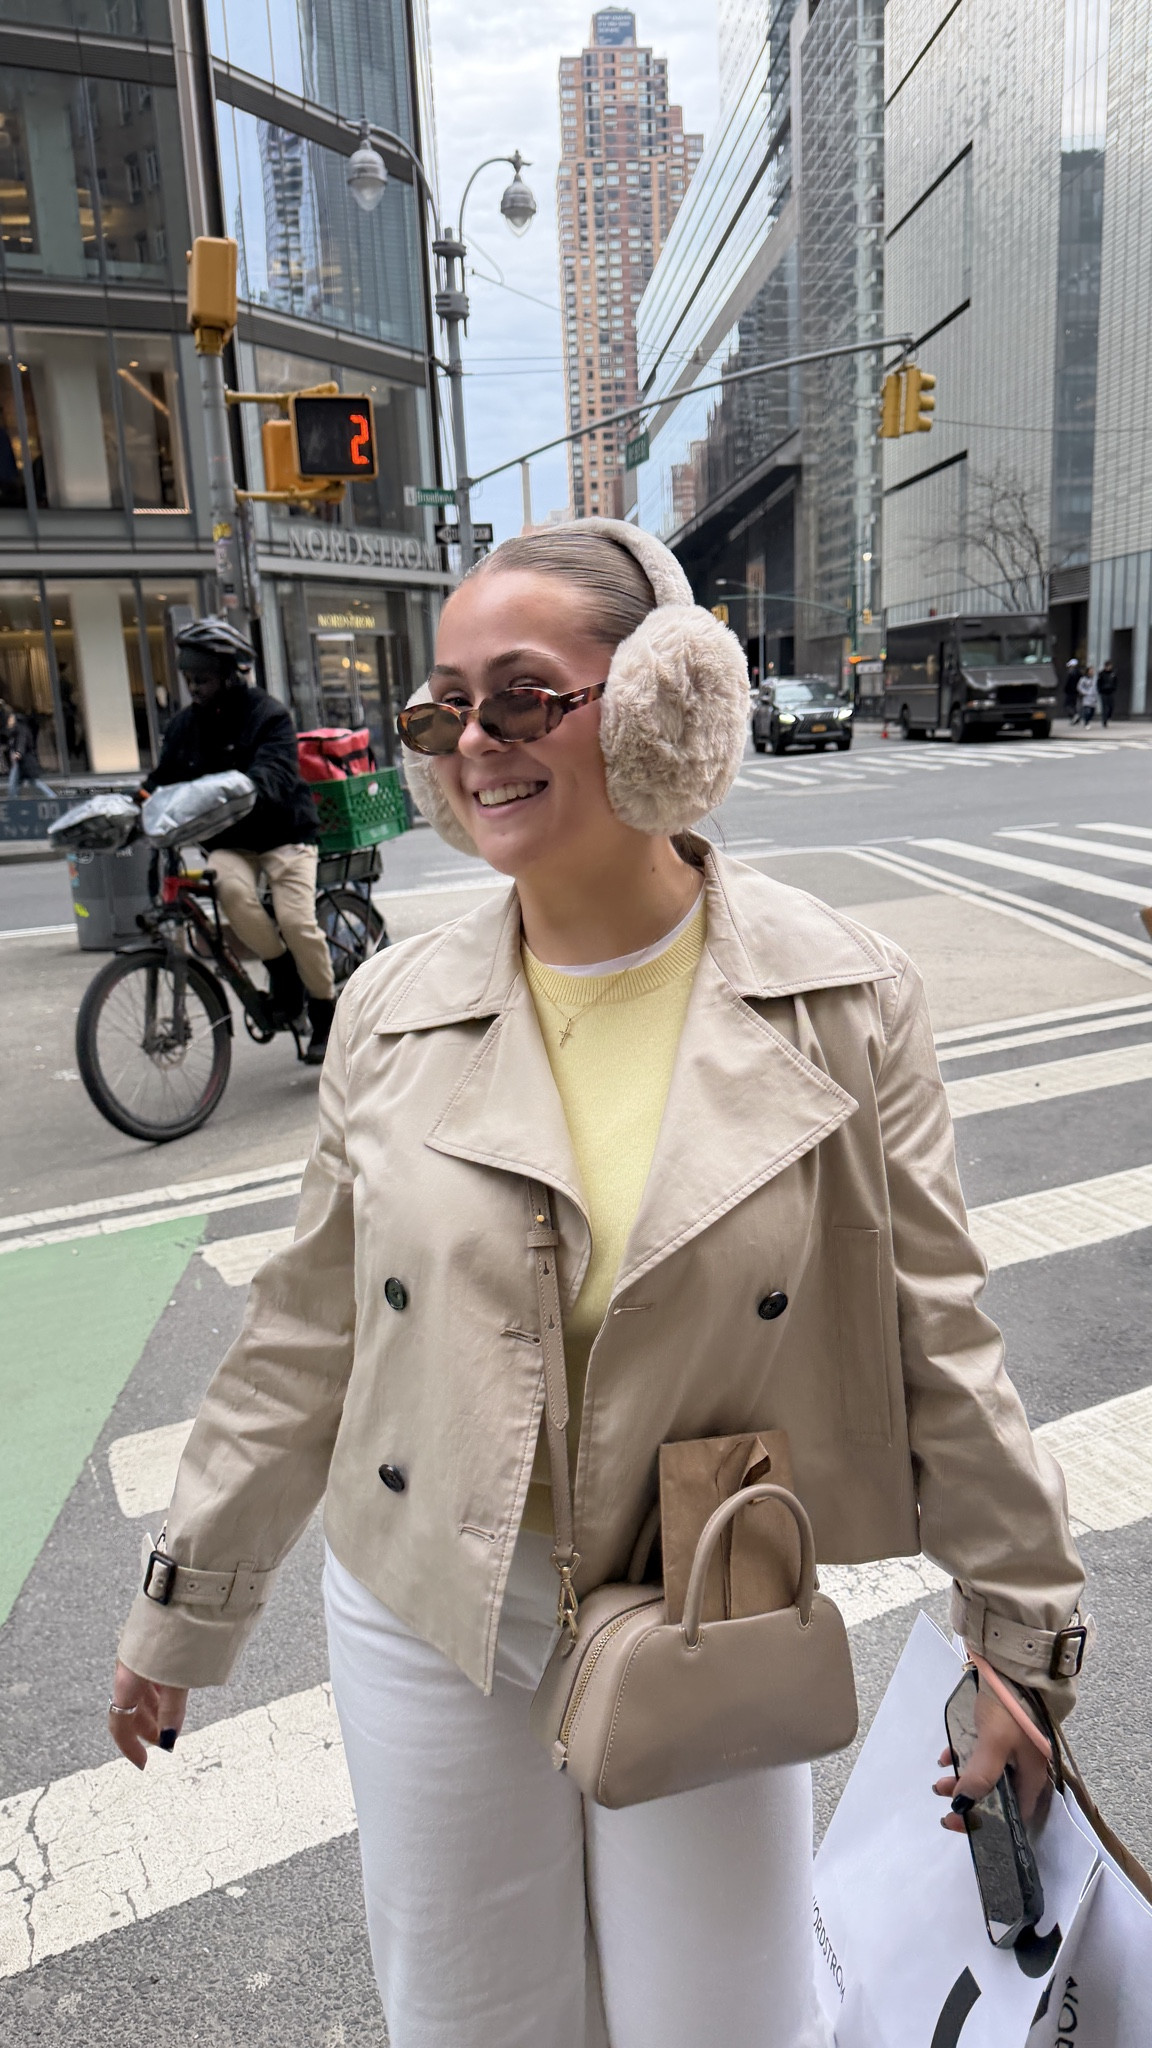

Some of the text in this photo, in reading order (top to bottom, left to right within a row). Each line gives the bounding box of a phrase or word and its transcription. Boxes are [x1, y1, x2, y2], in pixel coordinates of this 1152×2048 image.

[350, 414, 370, 465] 2
[288, 526, 441, 573] NORDSTROM
[317, 613, 375, 629] NORDSTROM
[813, 1895, 846, 2004] ORDSTROM
